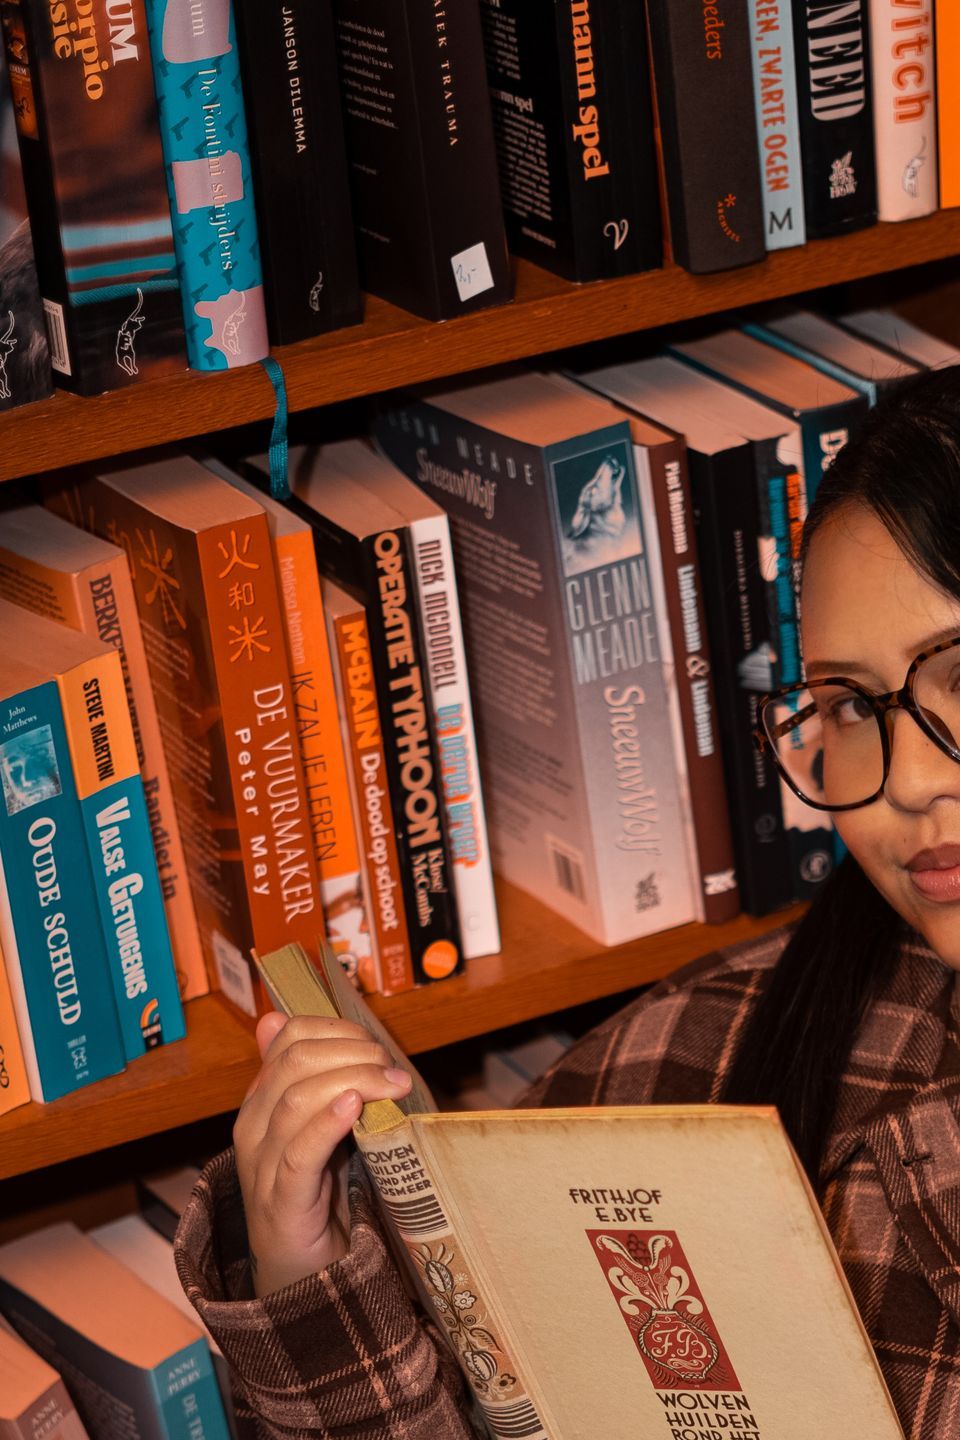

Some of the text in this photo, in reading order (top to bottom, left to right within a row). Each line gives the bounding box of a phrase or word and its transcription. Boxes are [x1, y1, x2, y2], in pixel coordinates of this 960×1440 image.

[50, 0, 72, 59] sie
[282, 6, 306, 154] JANSON DILEMMA
[441, 60, 458, 146] TRAUMA
[759, 47, 786, 129] ZWARTE
[198, 68, 235, 271] De Fontini strijders
[573, 105, 610, 181] spel
[764, 134, 790, 192] OGEN
[280, 557, 306, 666] Melissa Nathan
[565, 559, 651, 632] GLENN
[571, 612, 659, 685] MEADE
[8, 705, 26, 720] John
[374, 531, 441, 848] OPERATIE TYPHOON
[3, 714, 37, 733] Matthews
[83, 678, 115, 782] STEVE MARTINI
[290, 670, 338, 863] IK ZAL JE LEREN
[360, 752, 381, 785] De
[604, 684, 663, 857] SneeuwWolf
[234, 727, 270, 896] Peter May
[253, 683, 315, 924] DE VUURMAKER
[363, 782, 390, 844] dood
[368, 840, 389, 866] op
[27, 816, 82, 1026] OUDE SCHULD
[374, 1168, 426, 1187] OND HET
[378, 1179, 432, 1197] OSMEER
[569, 1188, 662, 1205] FRITHJOF
[595, 1207, 653, 1223] E.BYE
[167, 1357, 198, 1381] ANNE
[168, 1368, 201, 1396] PERRY
[656, 1392, 750, 1411] WOLVEN
[665, 1412, 758, 1429] HUILDEN
